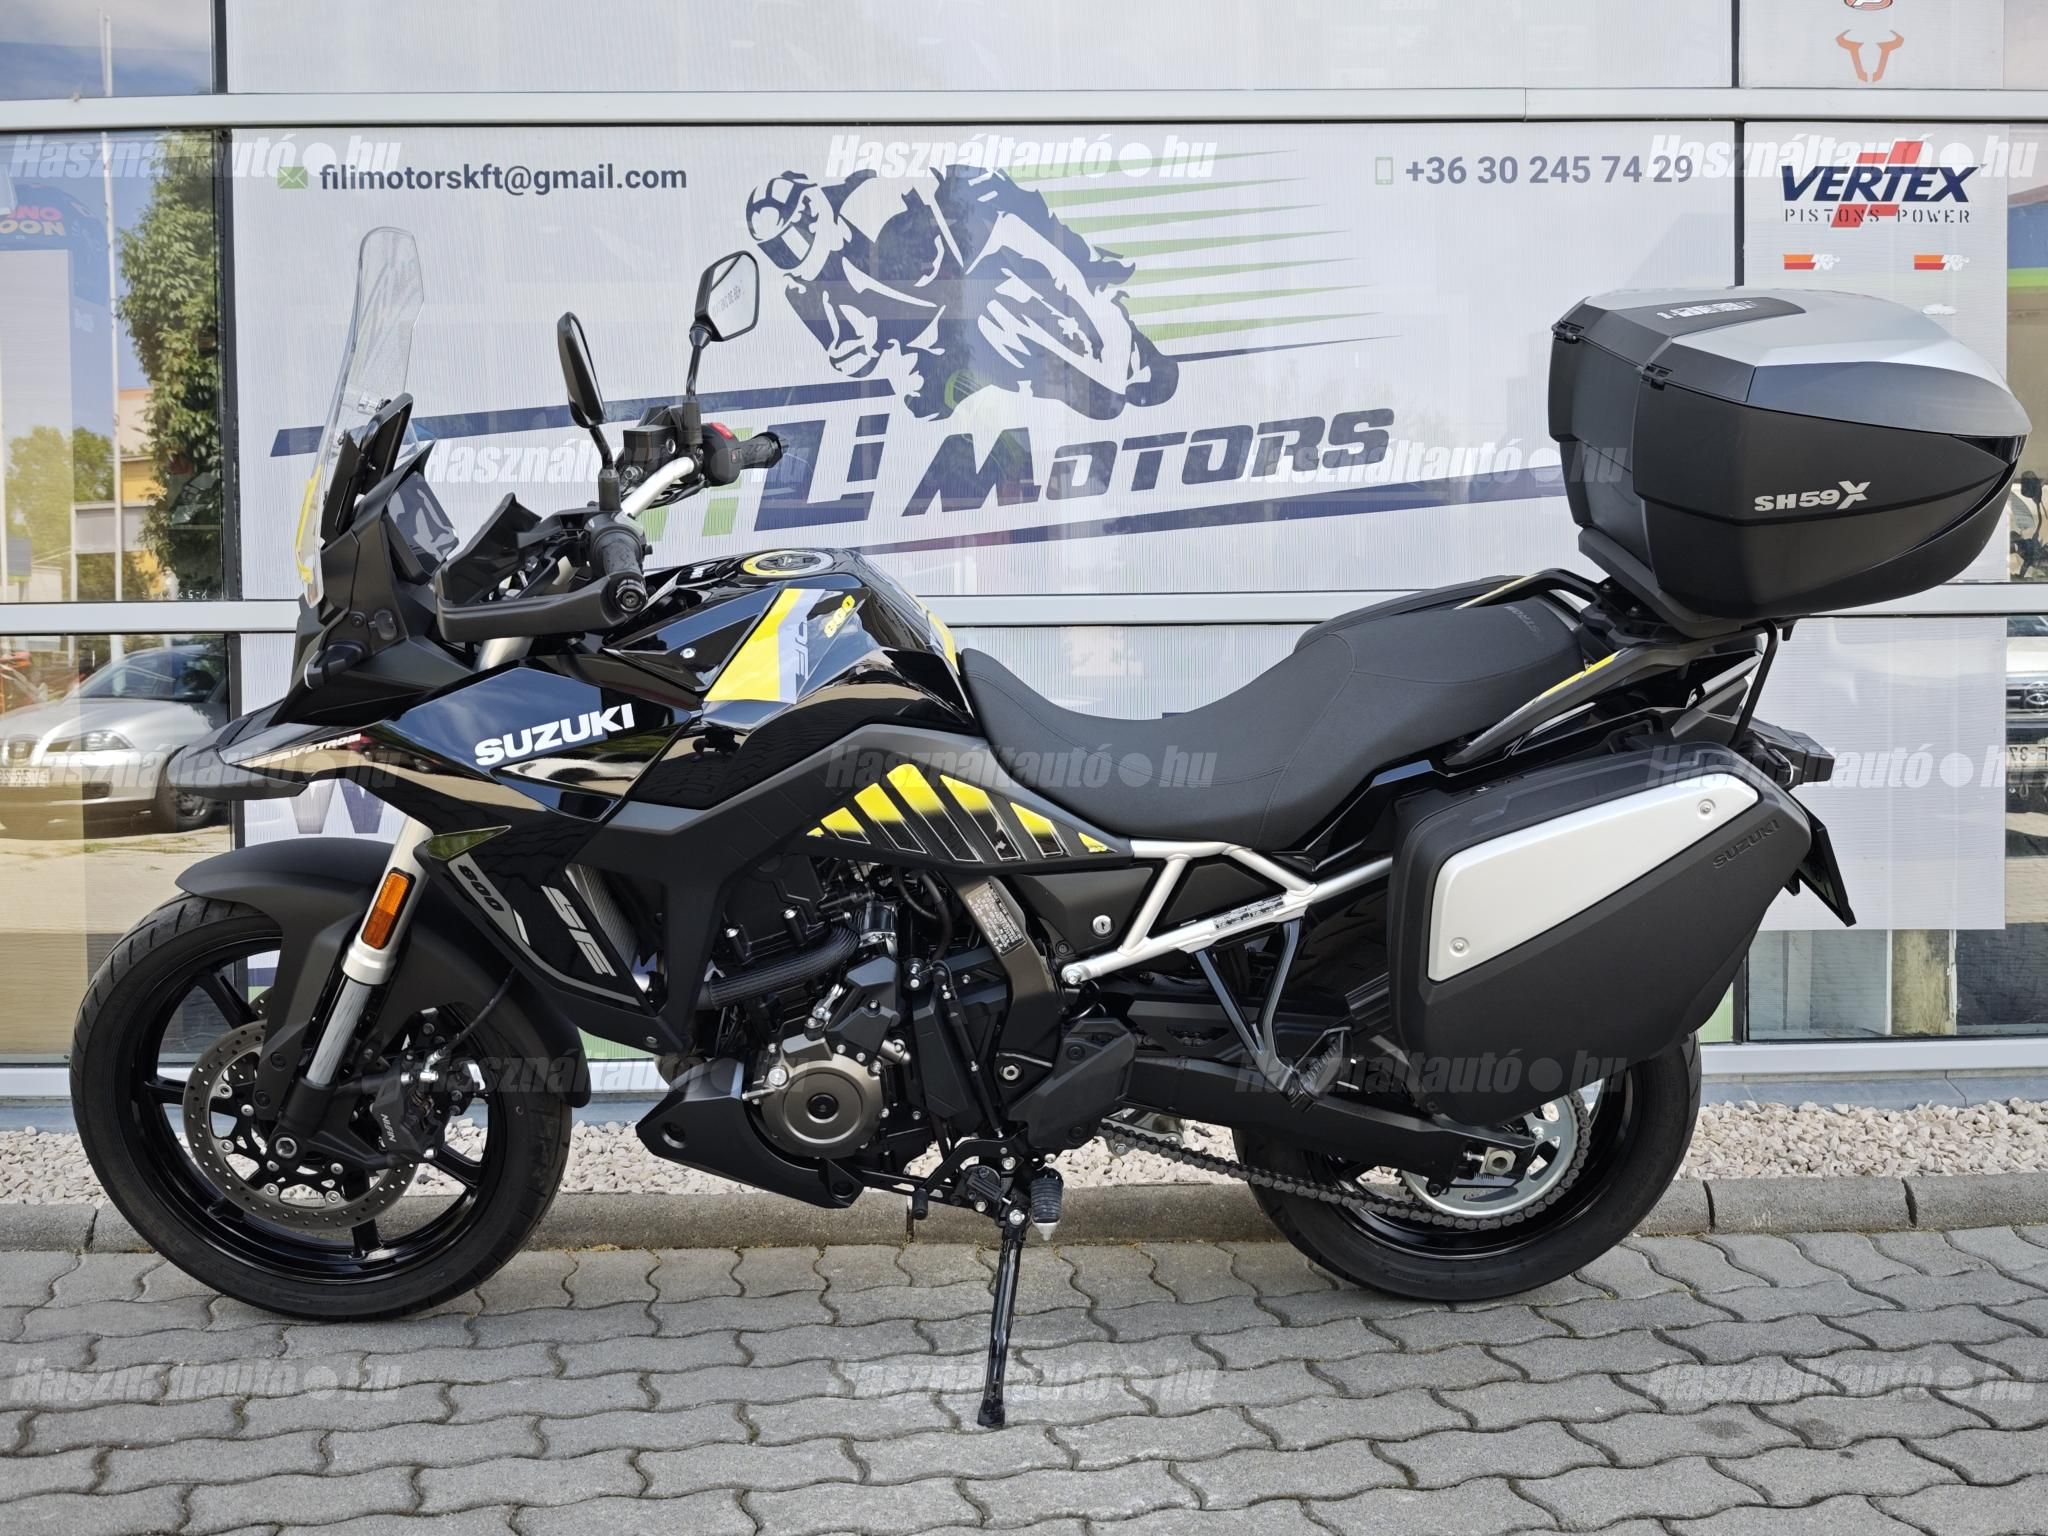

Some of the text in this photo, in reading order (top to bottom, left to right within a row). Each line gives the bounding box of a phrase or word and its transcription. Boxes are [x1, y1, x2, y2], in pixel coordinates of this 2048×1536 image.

[320, 164, 687, 195] filimotorskft@gmail.com
[1406, 155, 1693, 184] +36 30 245 74 29
[1781, 165, 1979, 202] VERTEX
[1785, 208, 1970, 223] PISTONS POWER
[901, 407, 1395, 517] MOTORS
[474, 703, 635, 766] SUZUKI
[1713, 820, 1780, 869] SUZUKI
